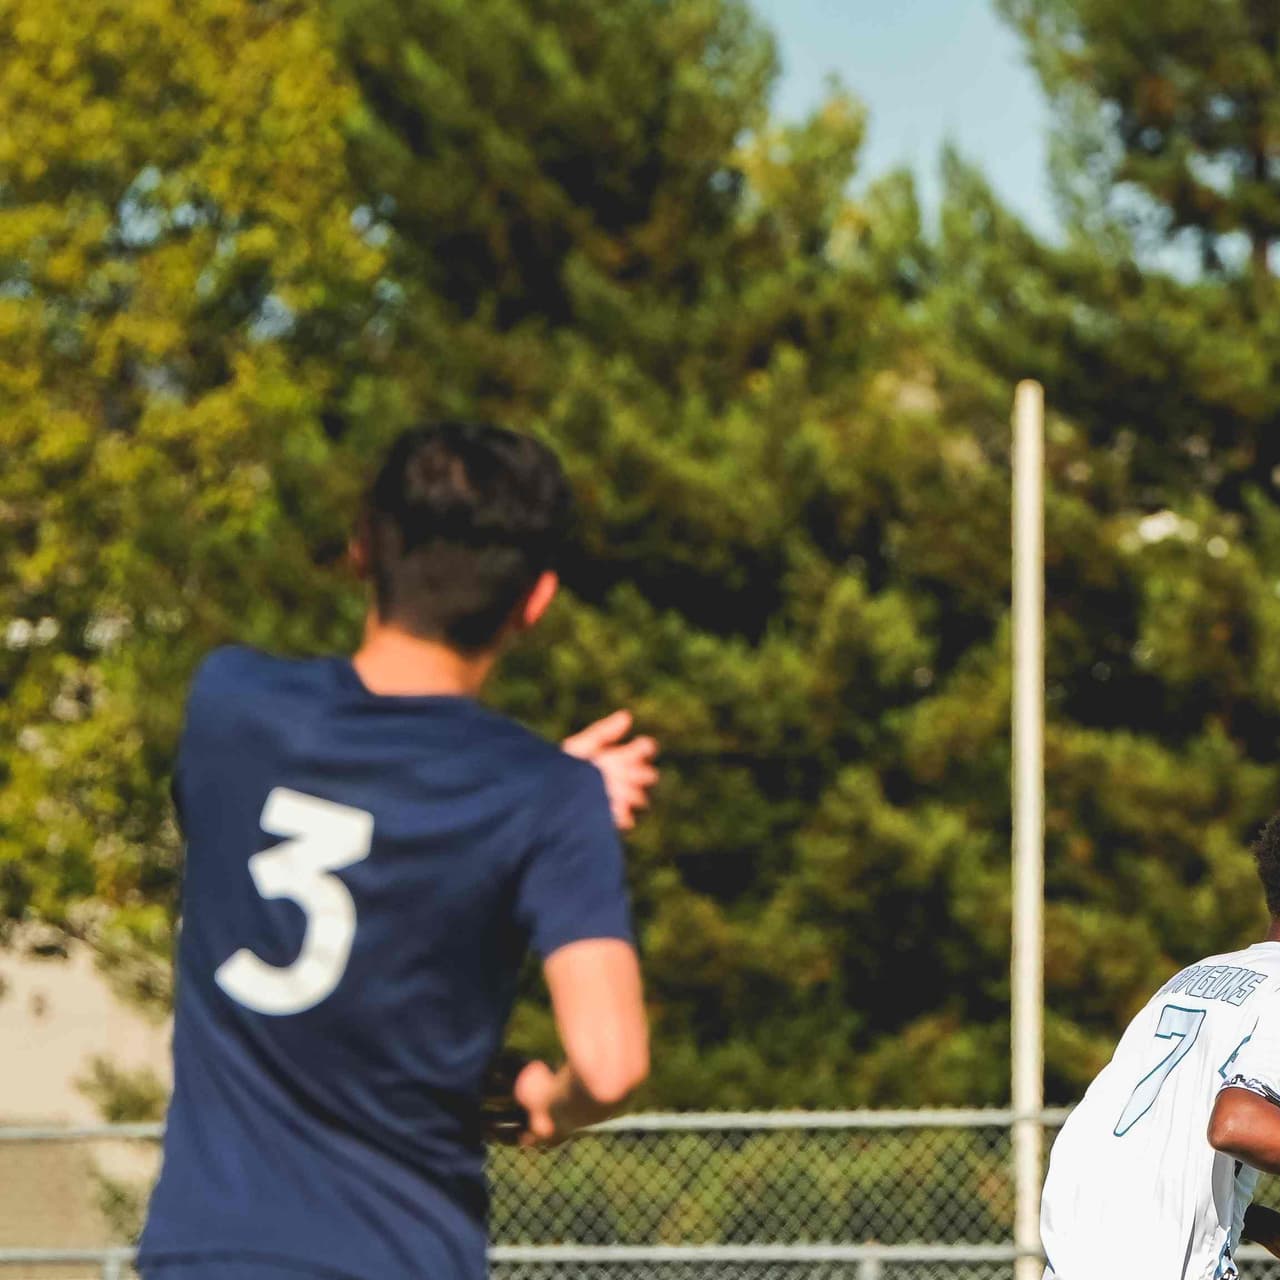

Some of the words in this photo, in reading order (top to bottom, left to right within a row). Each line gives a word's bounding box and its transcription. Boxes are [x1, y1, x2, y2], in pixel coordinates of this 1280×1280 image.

[213, 785, 375, 1017] 3
[1158, 964, 1269, 1007] RAGONS
[1112, 1003, 1208, 1138] 7
